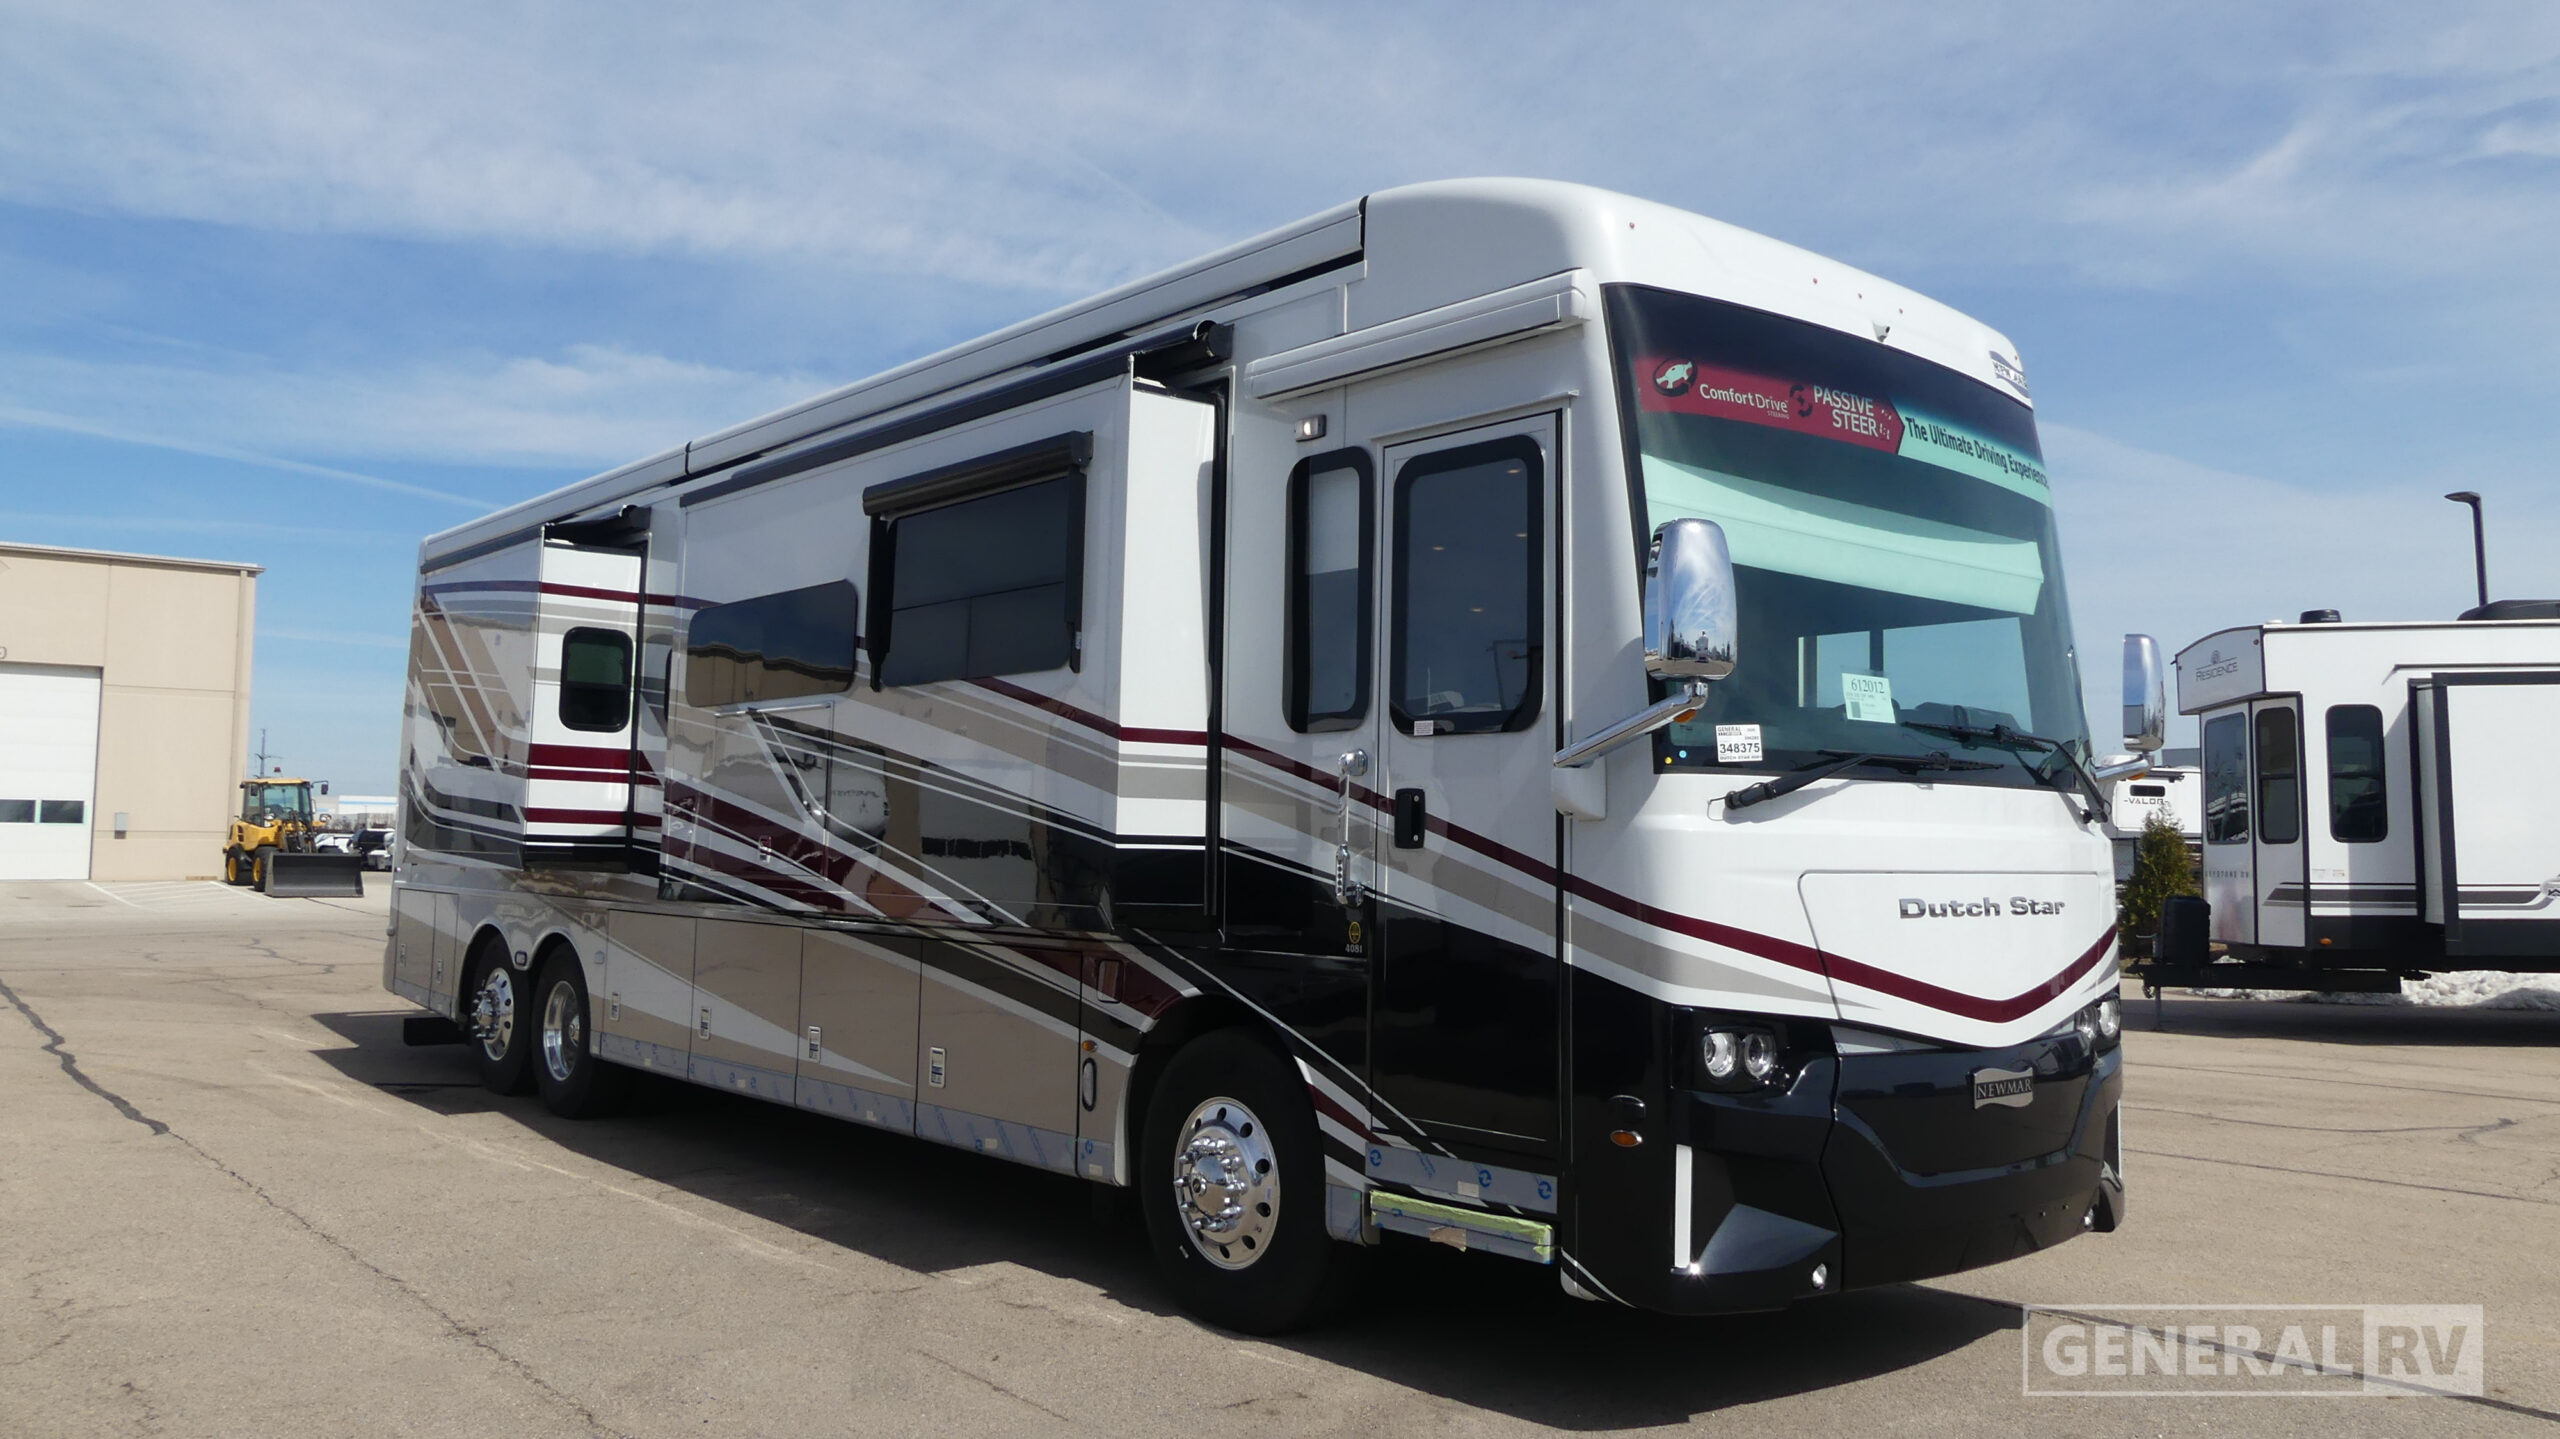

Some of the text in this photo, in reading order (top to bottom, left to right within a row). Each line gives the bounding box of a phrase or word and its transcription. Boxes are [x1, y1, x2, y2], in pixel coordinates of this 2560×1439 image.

[1813, 384, 1875, 417] PASSIVE
[1832, 409, 1880, 438] STEER
[1905, 416, 2051, 490] The Ultimate Driving Experienc
[2195, 661, 2238, 682] RESIDENCE
[1851, 678, 1885, 694] 612012
[1719, 742, 1761, 754] 348375
[1898, 896, 2066, 919] Dutch Star
[1344, 943, 1363, 953] 4081
[1976, 1078, 2032, 1099] NEWMAR
